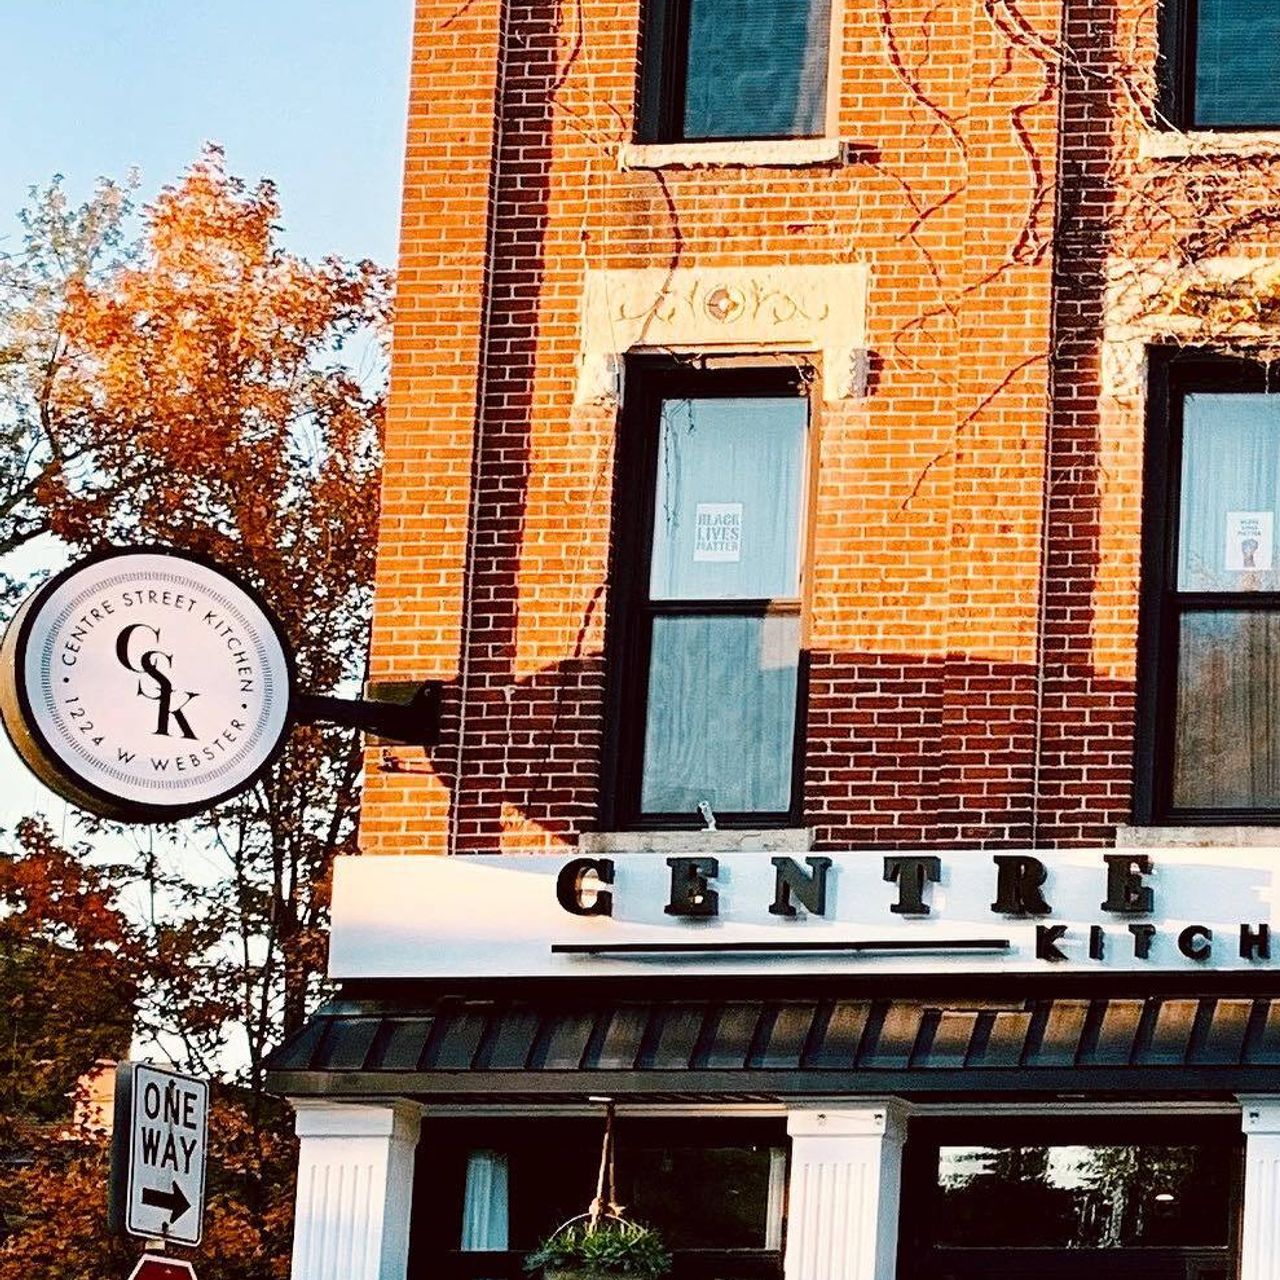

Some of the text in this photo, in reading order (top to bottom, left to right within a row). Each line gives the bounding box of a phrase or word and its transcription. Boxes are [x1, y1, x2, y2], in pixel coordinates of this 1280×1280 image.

[695, 541, 739, 552] MATTER
[697, 526, 739, 541] LIVES
[61, 590, 254, 694] CENTRE STREET KITCHEN
[64, 696, 247, 772] 1224 W WEBSTER
[556, 853, 1156, 919] CENTRE
[144, 1081, 198, 1131] ONE
[141, 1126, 198, 1175] WAY
